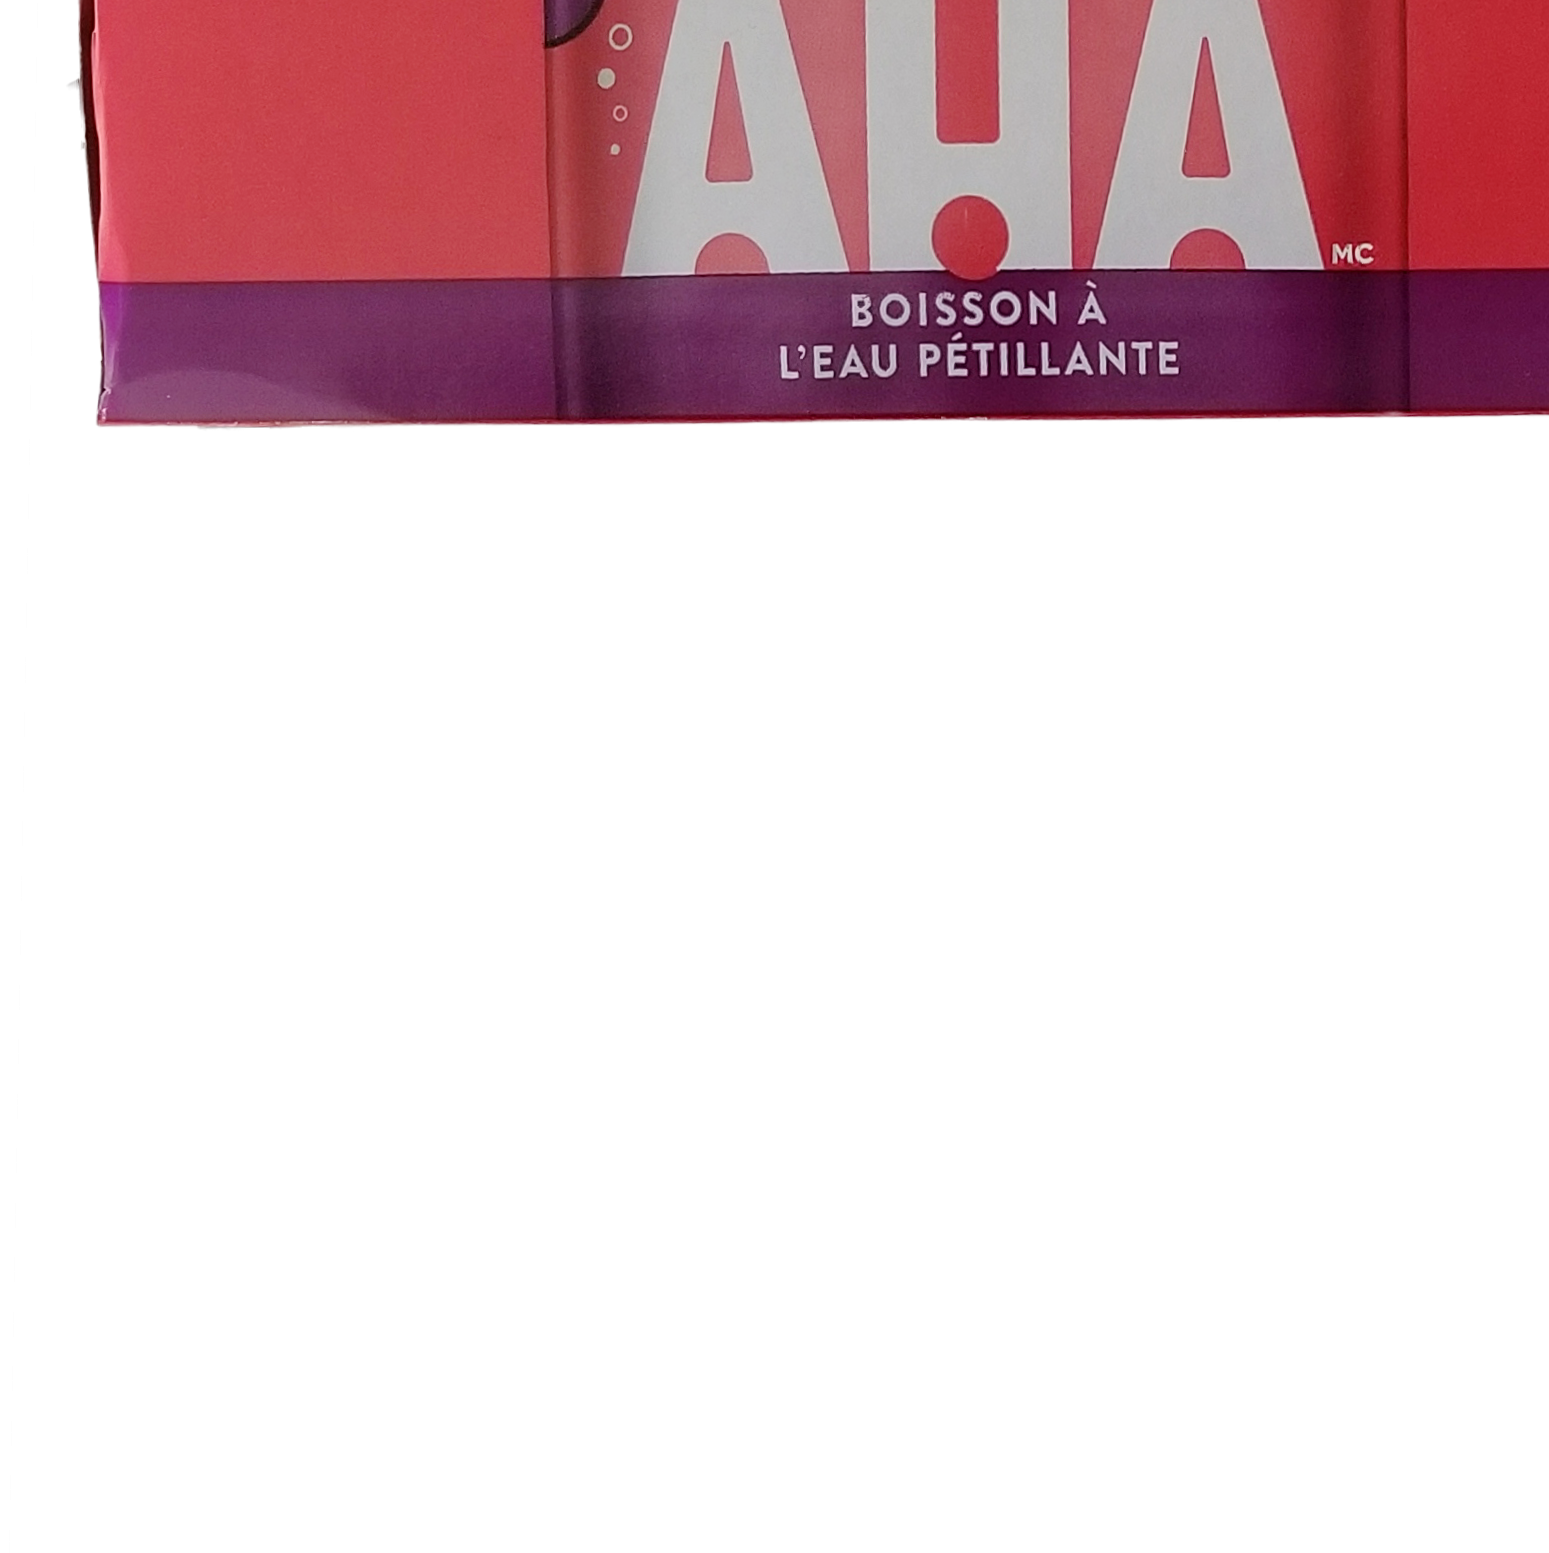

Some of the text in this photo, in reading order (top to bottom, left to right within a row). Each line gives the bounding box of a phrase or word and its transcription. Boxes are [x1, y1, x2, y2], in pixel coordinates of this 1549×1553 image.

[1332, 242, 1374, 265] MC
[850, 282, 1108, 329] BOISSON À
[920, 332, 1181, 378] PÉTILLANTE
